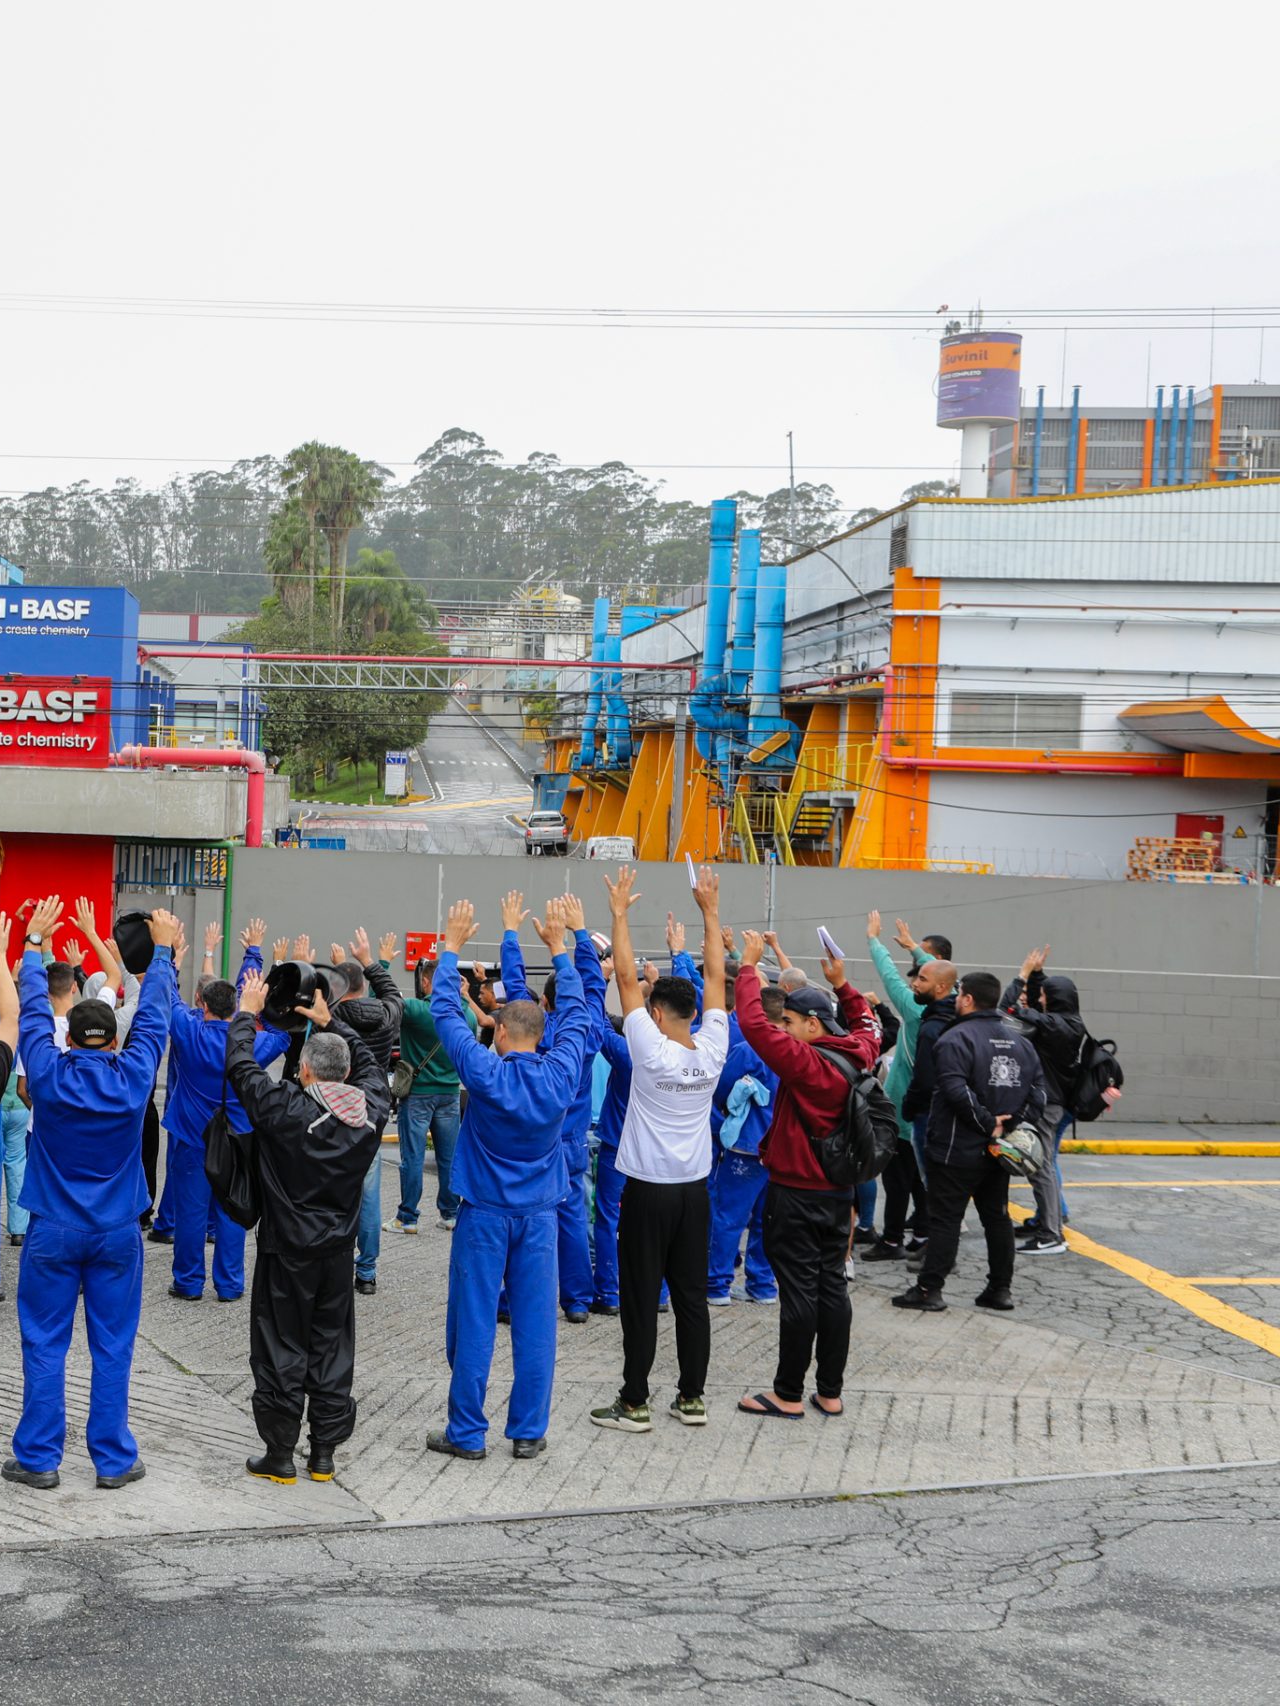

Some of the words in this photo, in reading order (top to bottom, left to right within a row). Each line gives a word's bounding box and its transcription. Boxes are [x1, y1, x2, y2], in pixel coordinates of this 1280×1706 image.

[945, 349, 988, 365] Suvinil
[22, 598, 90, 621] BASF
[5, 625, 38, 636] create
[39, 625, 90, 638] chemistry
[17, 732, 97, 752] chemistry
[681, 1067, 689, 1077] S
[655, 1081, 673, 1092] Site
